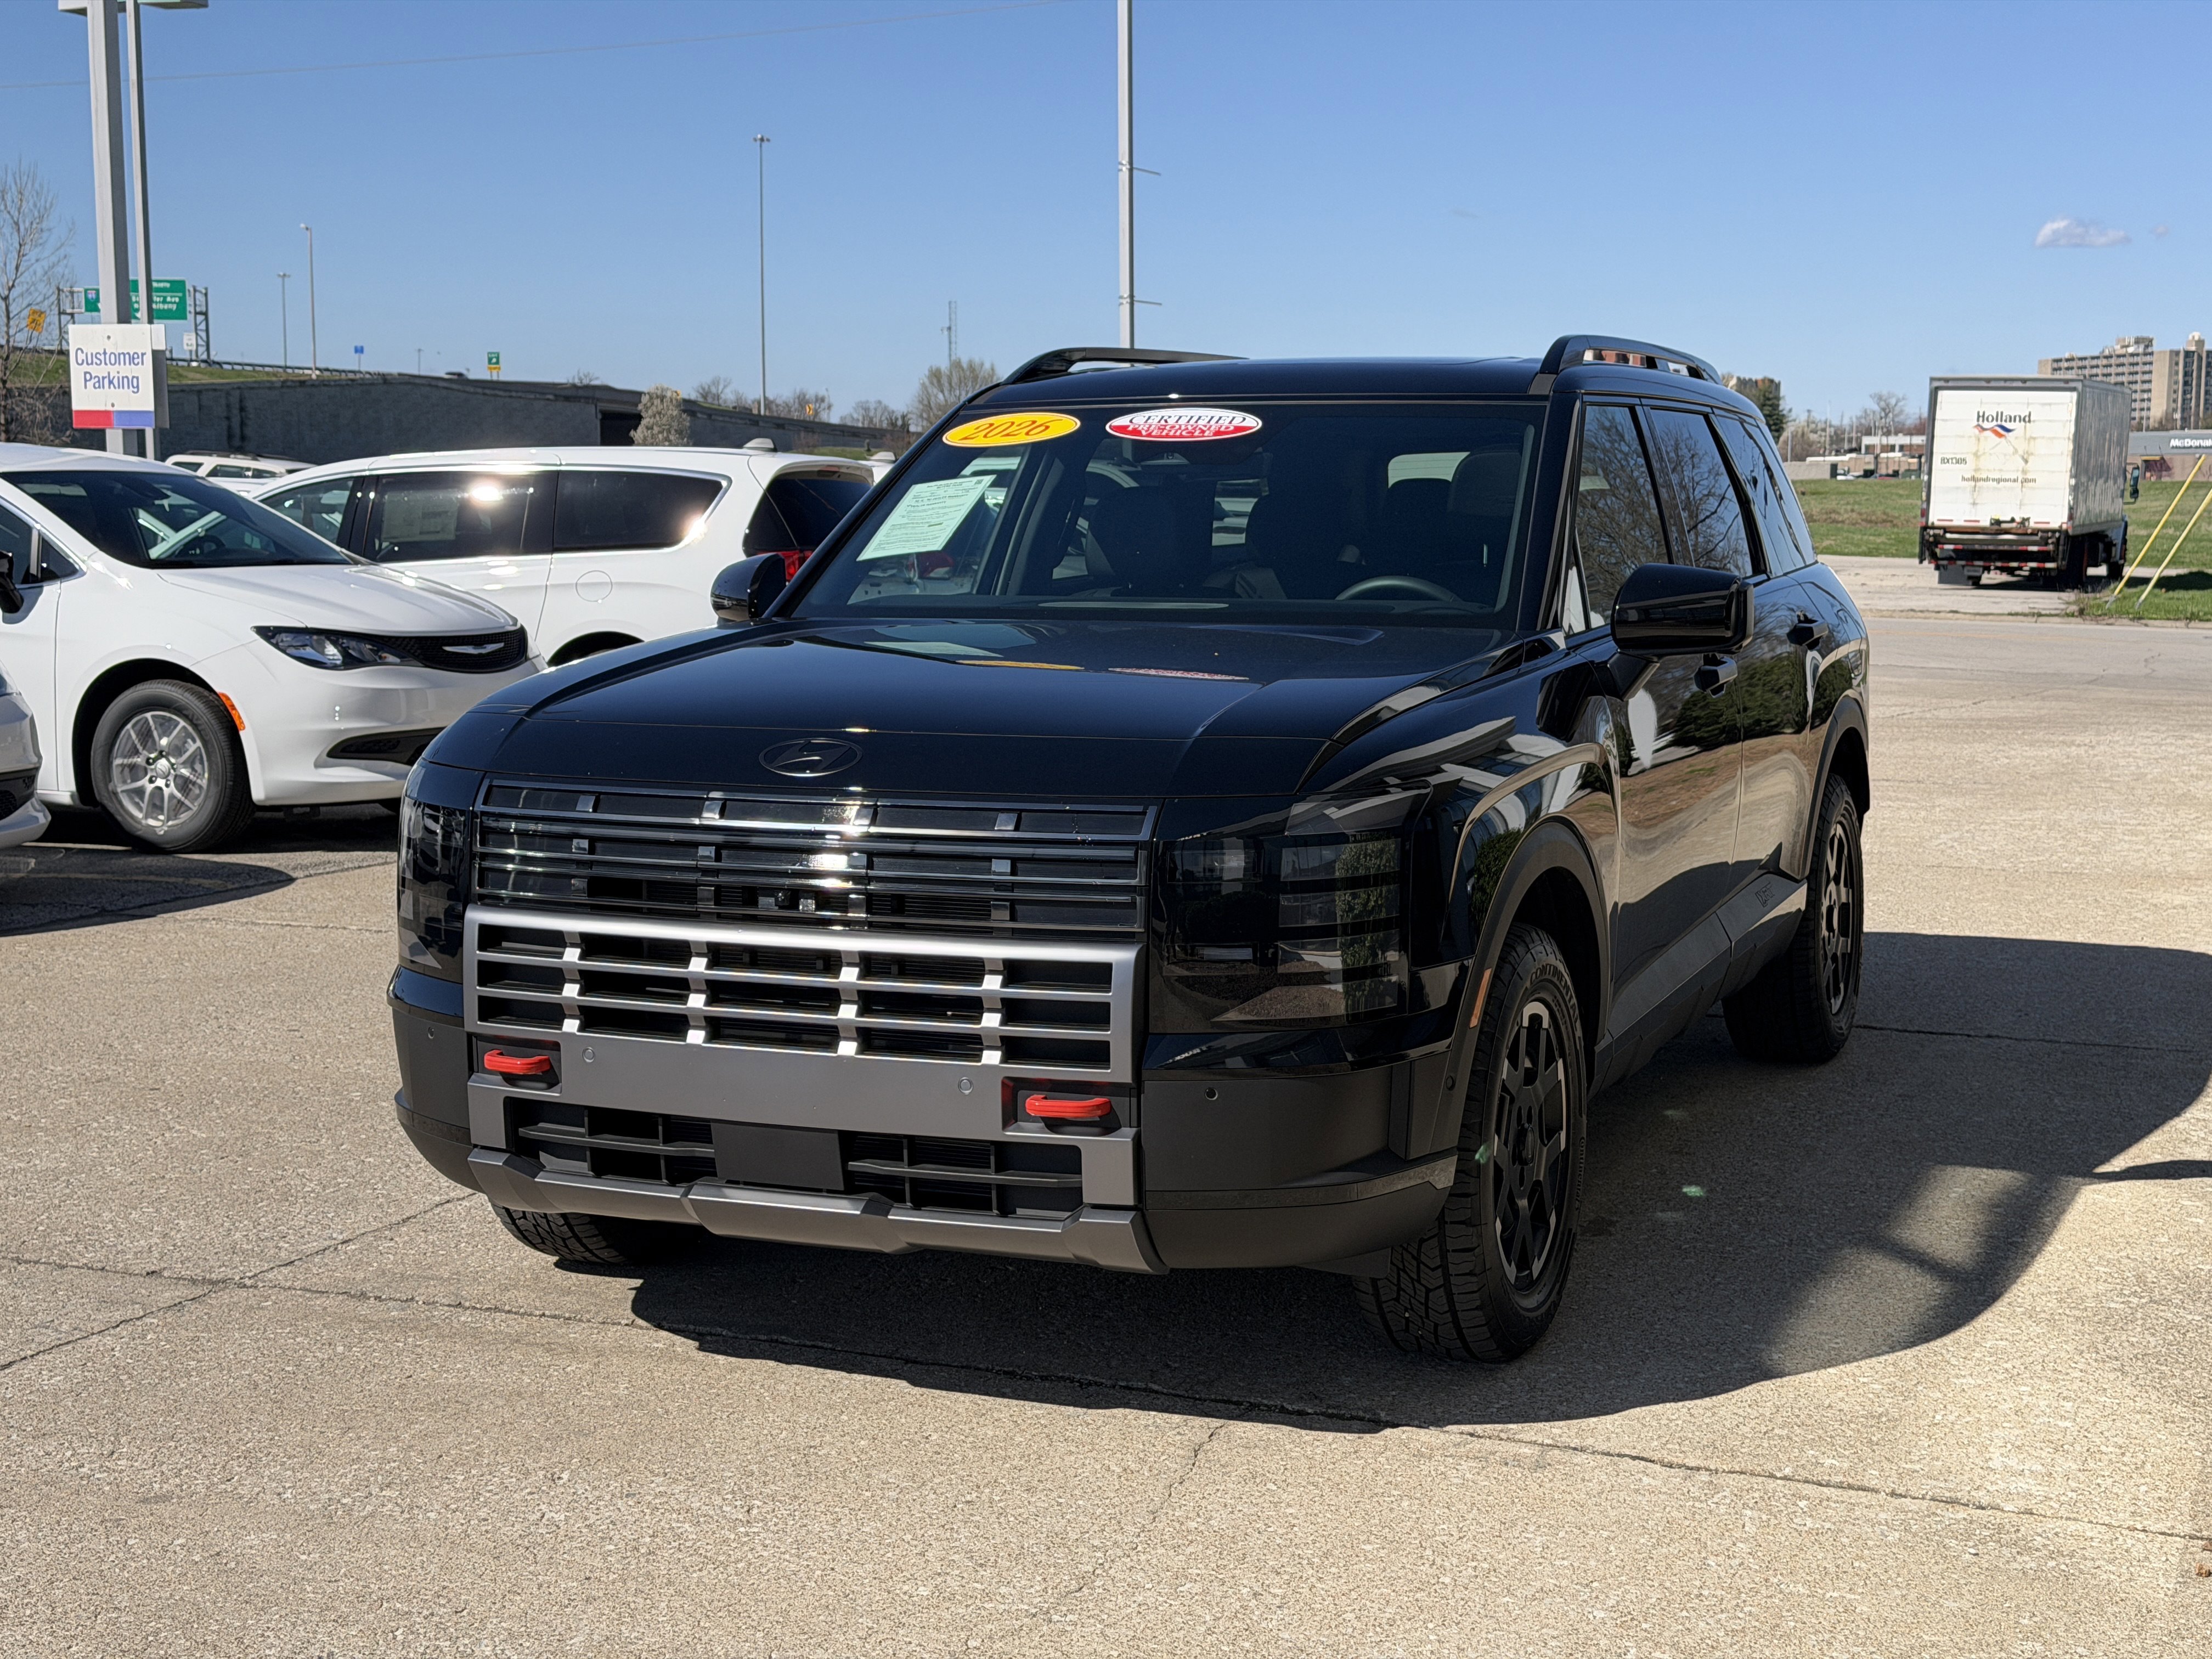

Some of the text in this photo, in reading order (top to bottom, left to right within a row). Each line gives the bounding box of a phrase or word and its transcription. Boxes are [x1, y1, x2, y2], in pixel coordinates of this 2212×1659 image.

[75, 347, 146, 366] Customer
[83, 371, 140, 394] Parking
[1128, 415, 1246, 425] CERTIFIED
[1976, 410, 2032, 424] Holland
[958, 419, 1063, 441] 2026
[2170, 438, 2212, 448] McDonal
[1530, 963, 1579, 1031] CONTINENTAL
